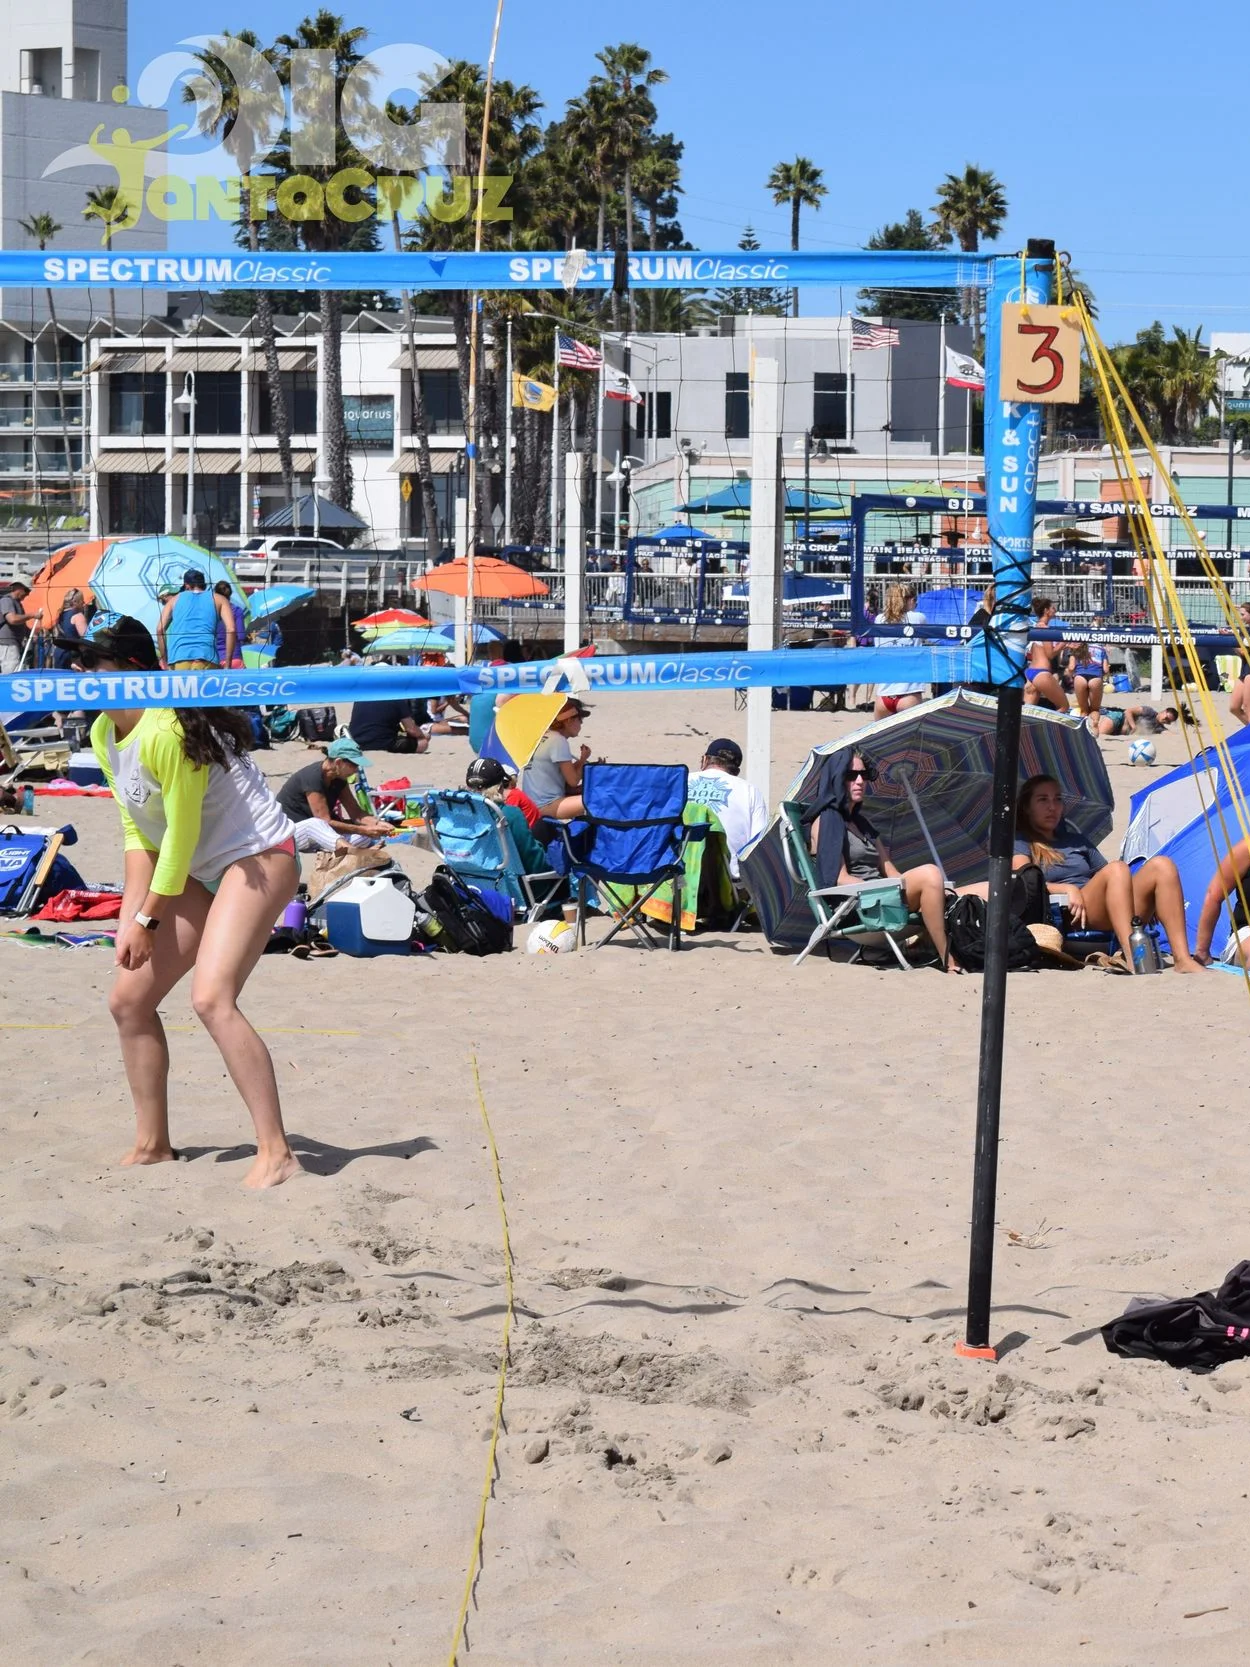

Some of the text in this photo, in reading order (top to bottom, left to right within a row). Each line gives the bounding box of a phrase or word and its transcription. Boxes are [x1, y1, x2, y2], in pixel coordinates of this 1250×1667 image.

[1017, 323, 1063, 394] 3
[808, 544, 839, 552] CRUZ
[897, 547, 938, 555] BEACH
